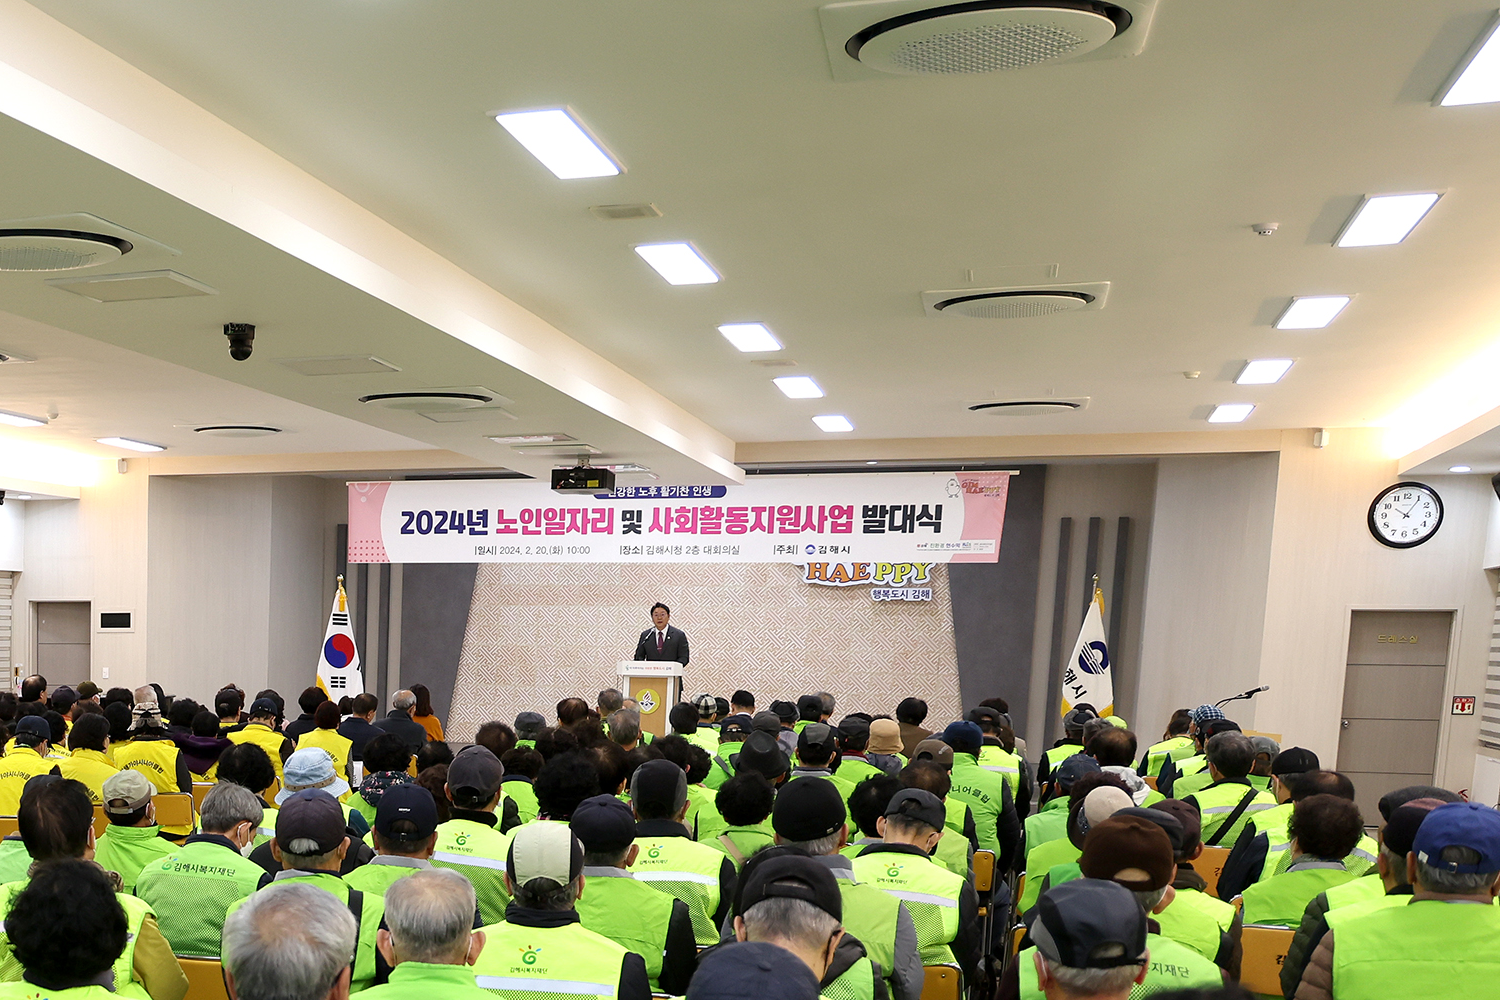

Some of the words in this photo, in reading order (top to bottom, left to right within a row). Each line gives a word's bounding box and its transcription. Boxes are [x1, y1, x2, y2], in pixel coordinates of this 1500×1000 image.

[638, 486, 658, 497] 노후
[660, 486, 690, 497] 활기찬
[693, 486, 712, 497] 인생
[400, 508, 488, 536] 2024년
[496, 506, 613, 535] 노인일자리
[621, 508, 642, 535] 및
[648, 504, 854, 535] 사회활동지원사업
[862, 503, 943, 534] 발대식
[567, 546, 591, 555] 10:00
[646, 546, 683, 555] 김해시청
[685, 546, 701, 555] 2층
[703, 545, 740, 555] 대회의실
[806, 561, 932, 584] HAEPPY
[872, 589, 909, 600] 행복도시
[911, 589, 930, 599] 김해
[1377, 633, 1419, 644] 드레스실
[1063, 667, 1088, 700] 해시
[120, 759, 164, 775] 해가야시니어클럽
[173, 862, 236, 878] 김해시복지재단
